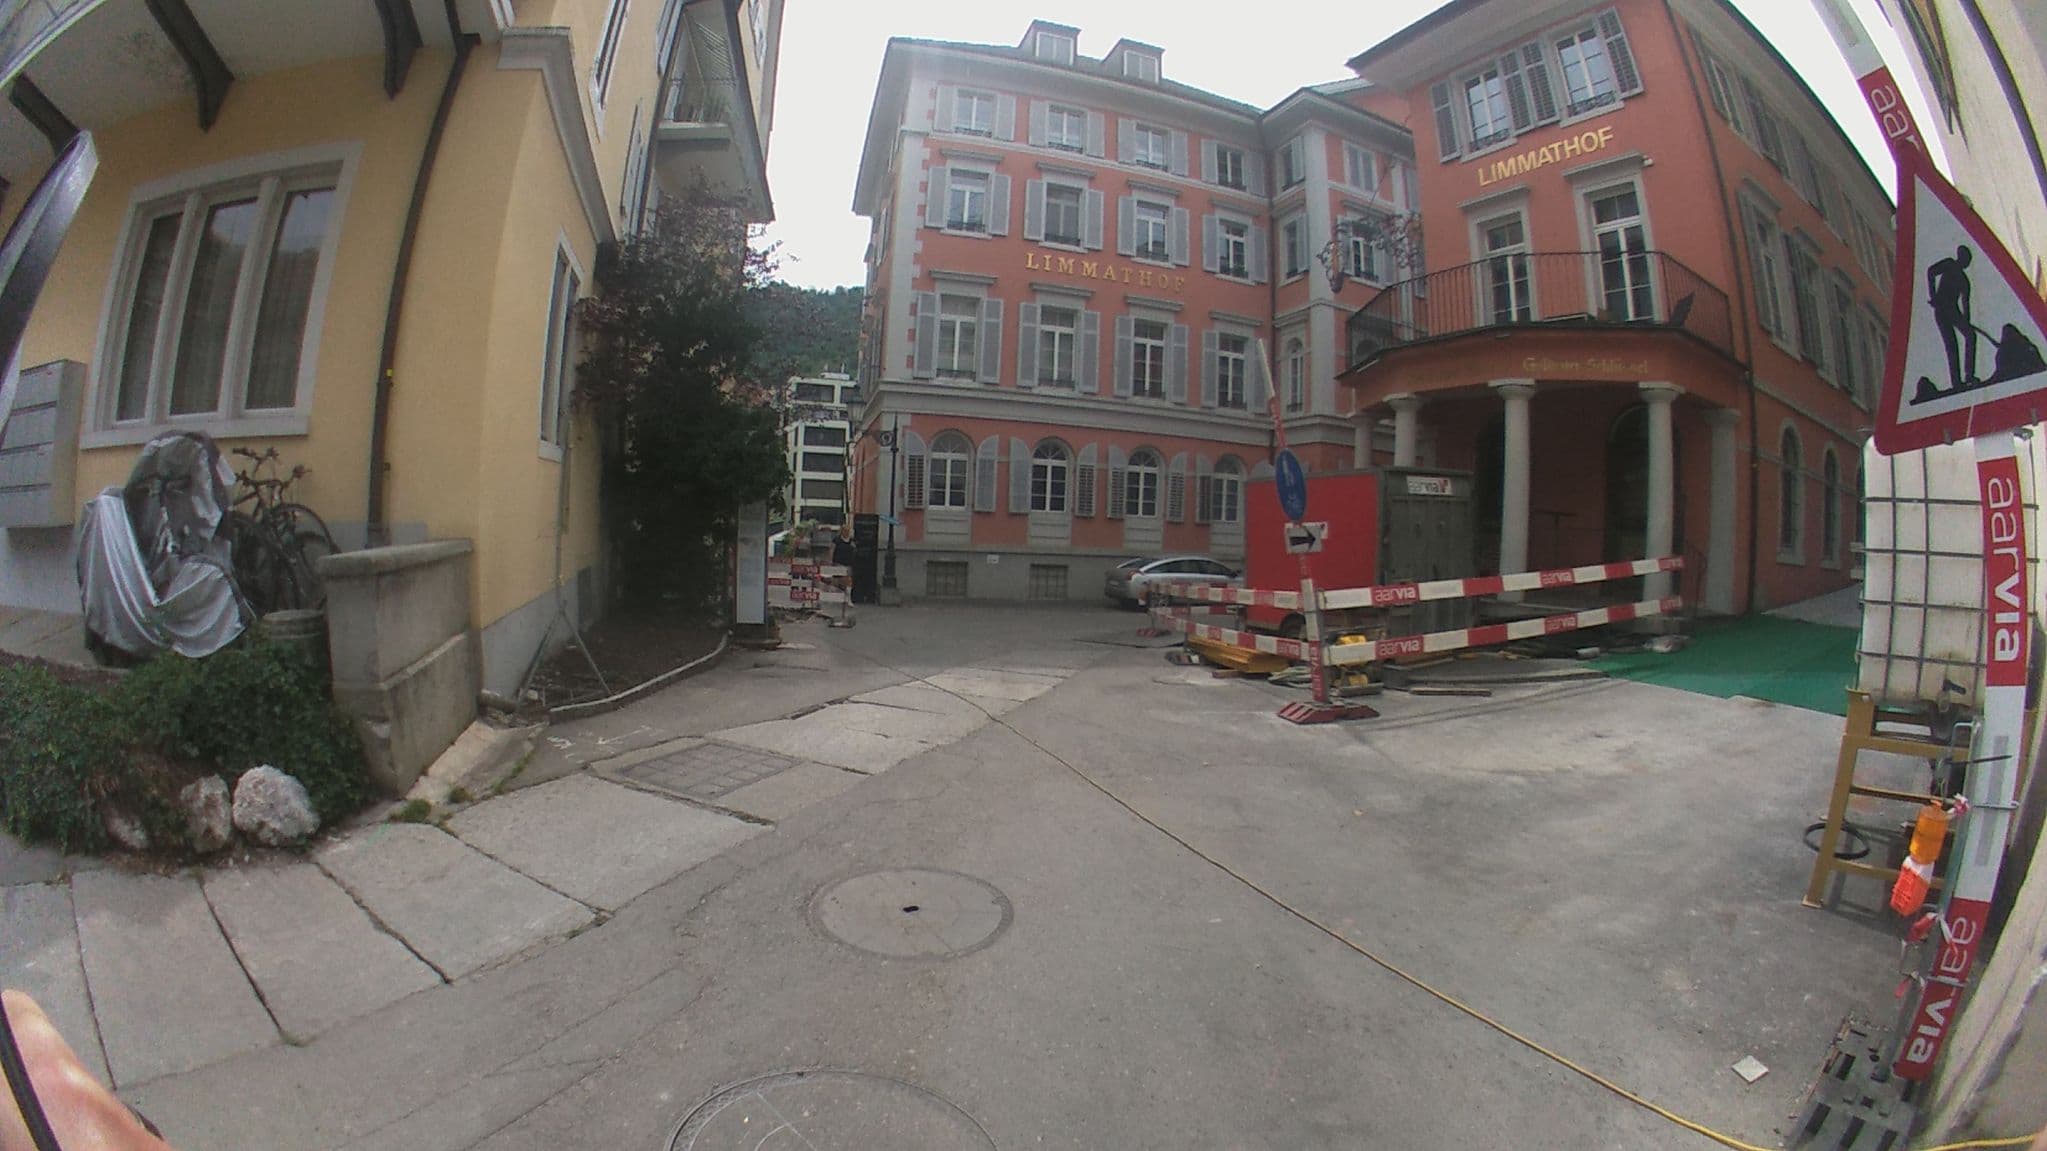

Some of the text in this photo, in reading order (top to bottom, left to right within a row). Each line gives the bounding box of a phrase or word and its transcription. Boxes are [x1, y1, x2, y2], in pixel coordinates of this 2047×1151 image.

[1476, 126, 1614, 187] LIMMATHOF
[1025, 252, 1186, 293] LIMMATHOF
[1375, 586, 1416, 602] aarvia
[1987, 477, 2020, 662] aarvia
[1380, 639, 1420, 656] aarvia
[1905, 916, 1976, 1064] aarvia
